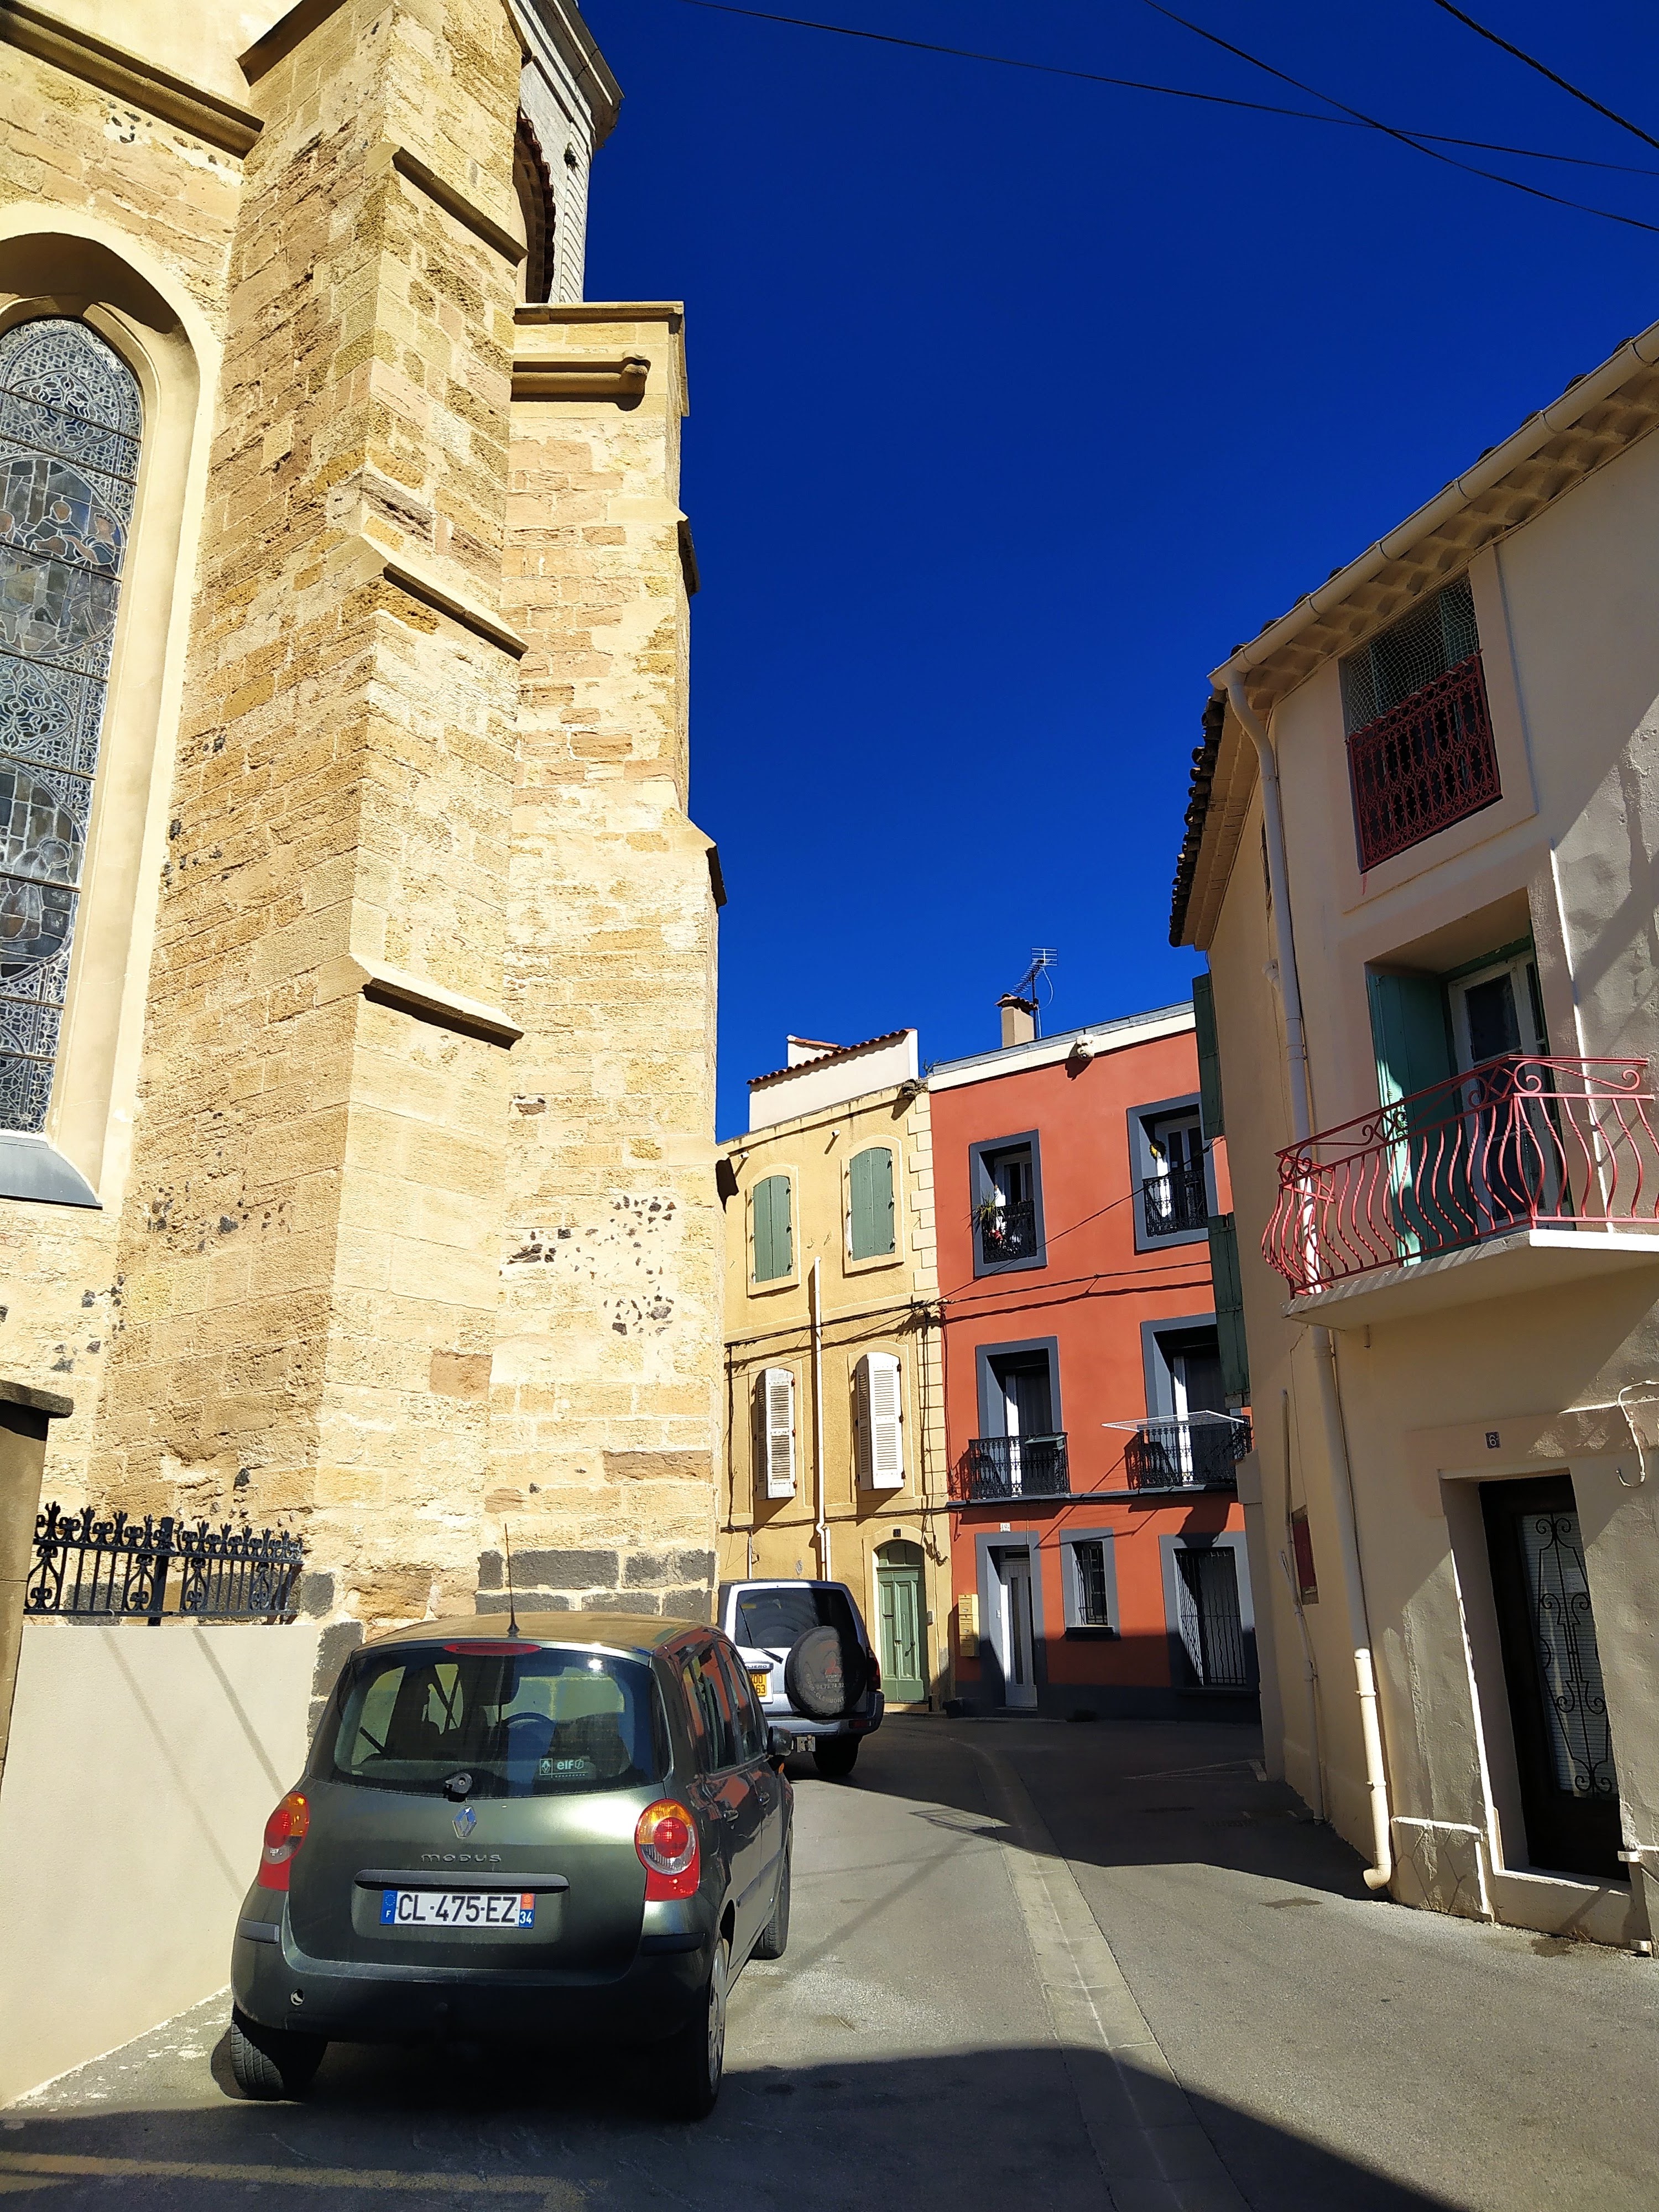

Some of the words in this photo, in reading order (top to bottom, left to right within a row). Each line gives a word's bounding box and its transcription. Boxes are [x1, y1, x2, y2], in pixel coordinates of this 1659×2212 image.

[1489, 1435, 1496, 1446] 6
[756, 1684, 766, 1694] 63
[557, 1760, 574, 1770] elf
[421, 1854, 502, 1863] MODUS
[398, 1893, 518, 1923] CL-475-EZ
[385, 1910, 392, 1918] F
[520, 1911, 532, 1924] 34
